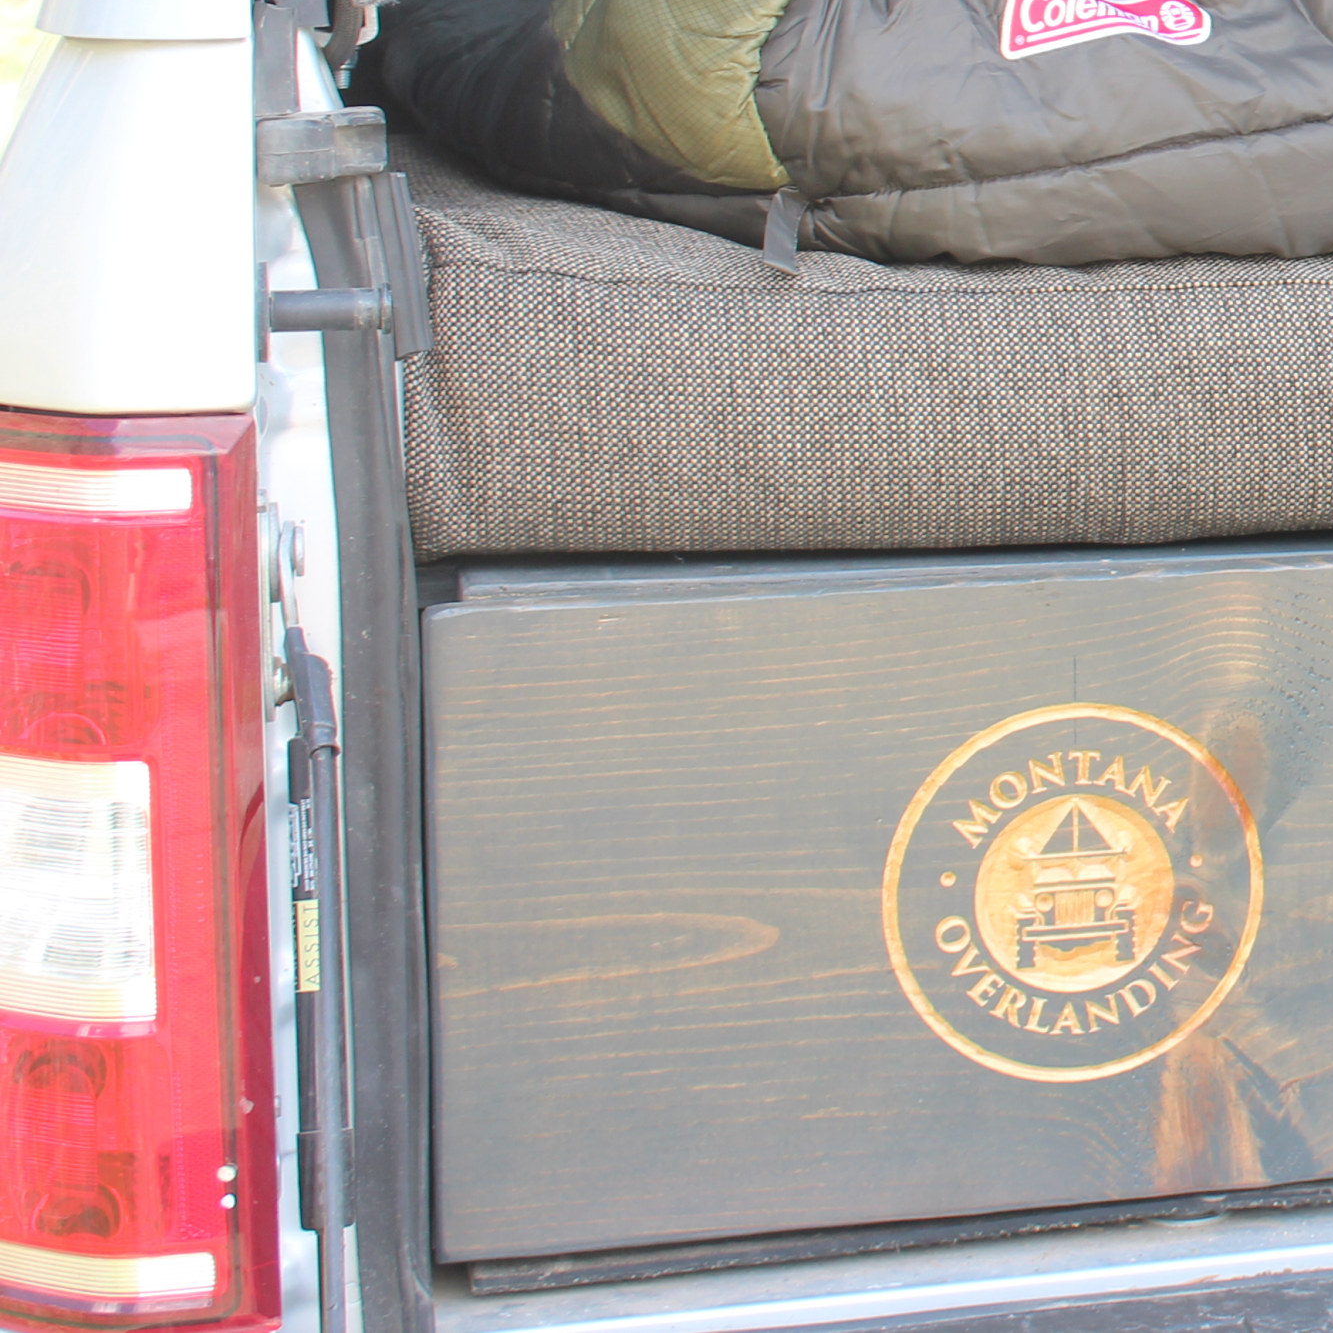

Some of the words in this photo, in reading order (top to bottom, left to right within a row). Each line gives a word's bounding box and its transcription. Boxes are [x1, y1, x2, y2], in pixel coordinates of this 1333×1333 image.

[952, 750, 1189, 848] MONTANA
[303, 905, 320, 986] ASSIST
[935, 900, 1214, 1035] OVERLANDING
